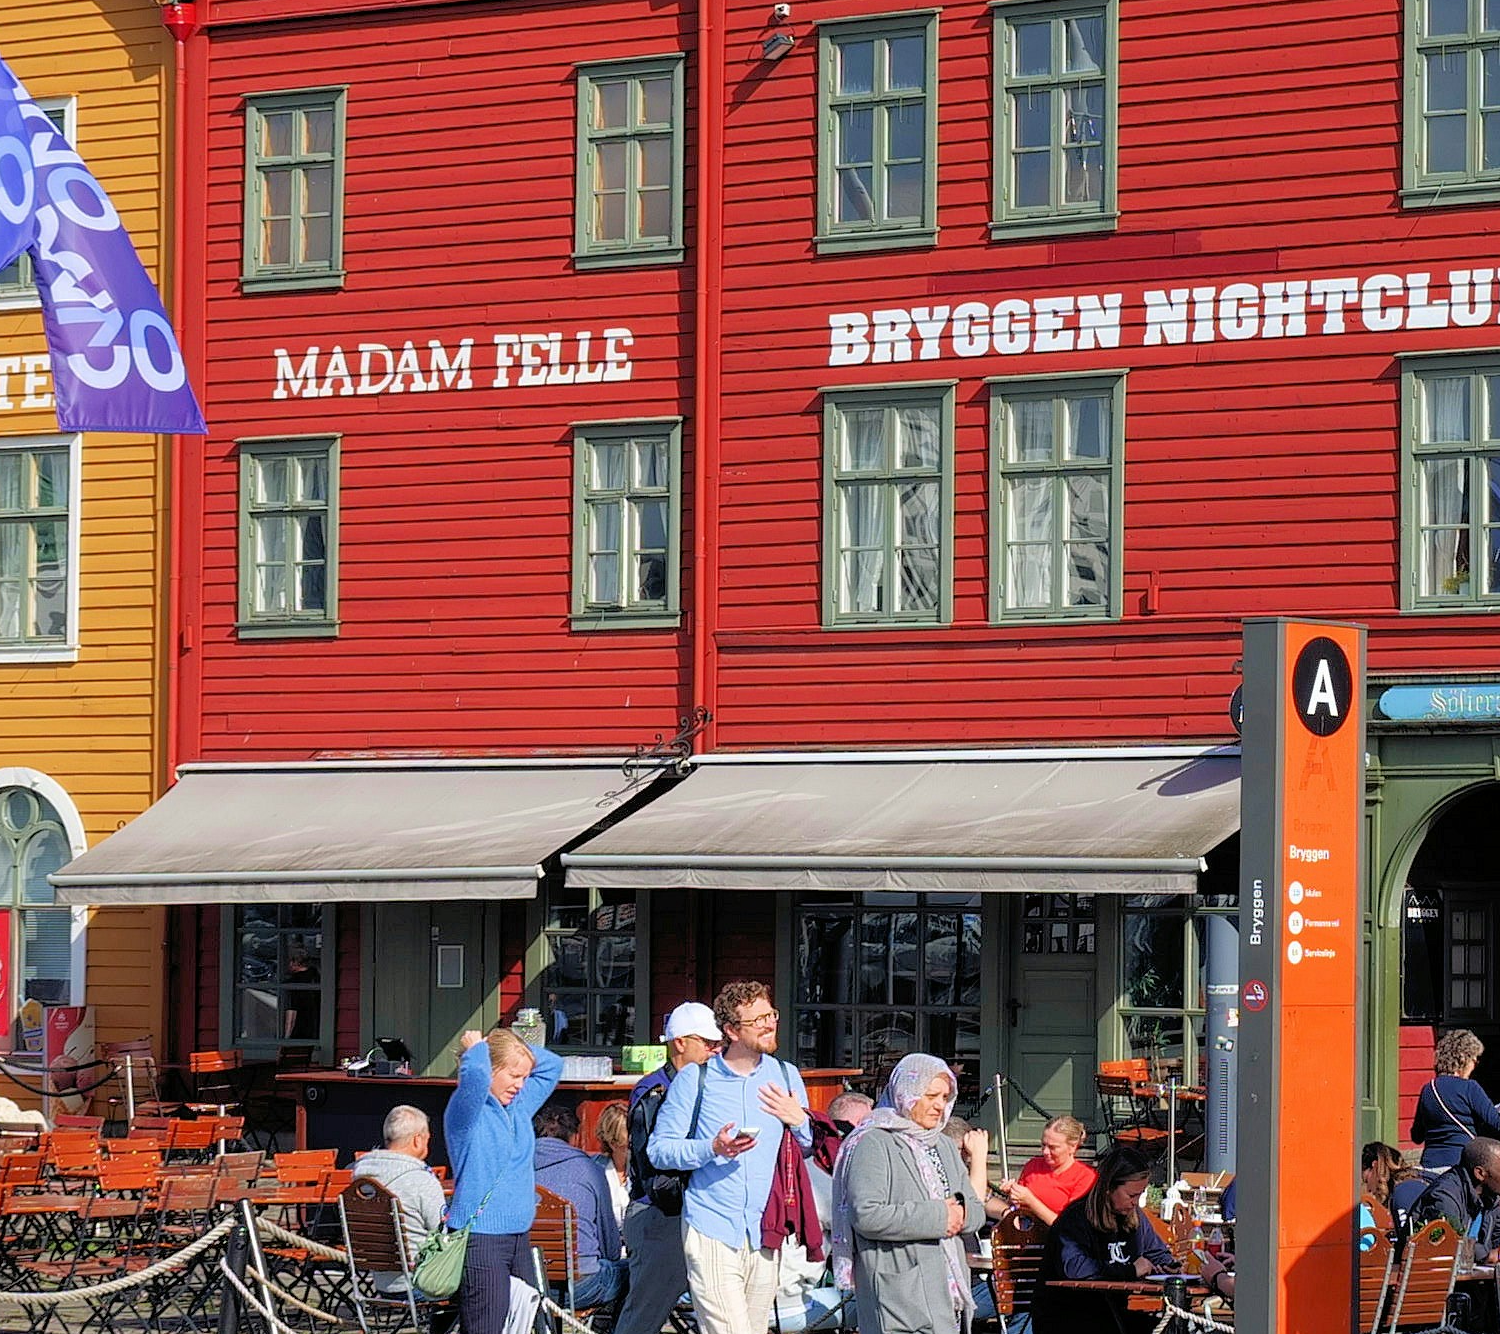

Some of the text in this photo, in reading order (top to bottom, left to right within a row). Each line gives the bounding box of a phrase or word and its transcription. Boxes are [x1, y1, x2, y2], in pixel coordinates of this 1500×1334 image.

[56, 309, 187, 392] 30
[273, 328, 634, 399] MADAM FELLE
[828, 293, 1123, 366] BRYGGEN
[1306, 658, 1339, 717] A
[1289, 845, 1330, 862] Bryggen
[1250, 879, 1265, 945] Bryggen
